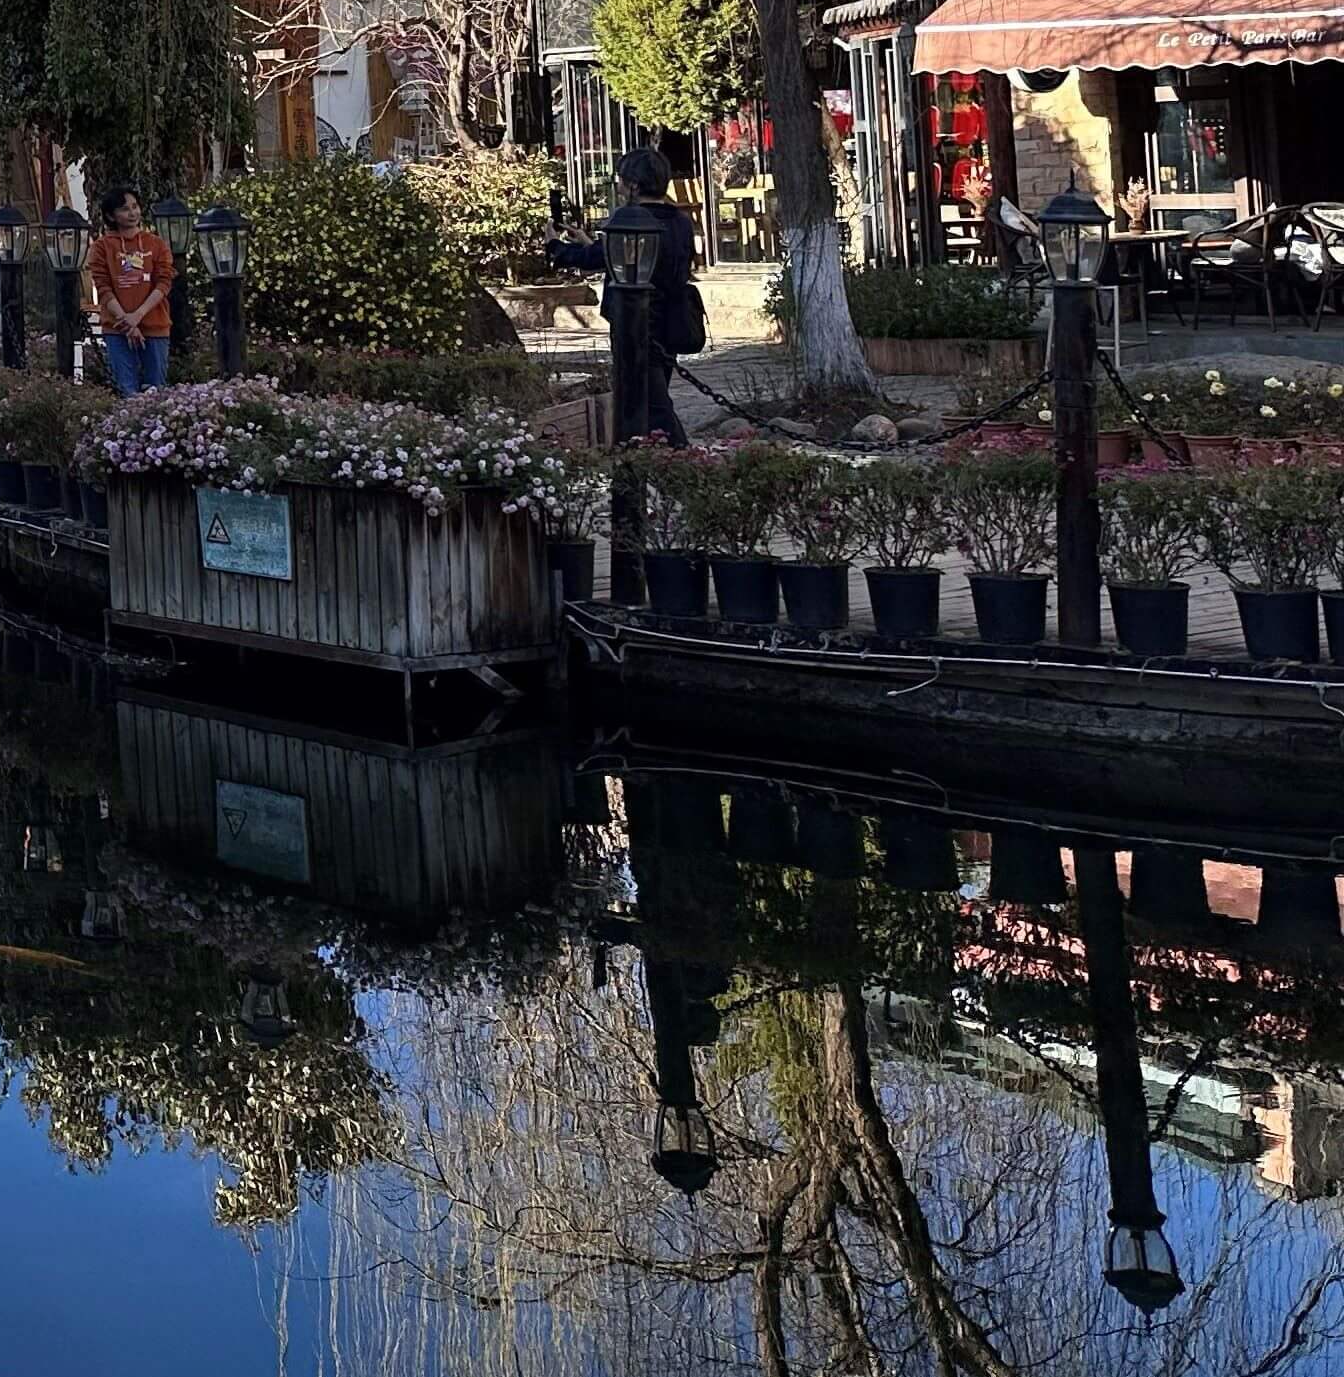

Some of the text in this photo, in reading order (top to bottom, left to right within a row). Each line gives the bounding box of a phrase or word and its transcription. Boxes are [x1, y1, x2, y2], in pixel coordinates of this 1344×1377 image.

[1157, 28, 1327, 48] Le Petit Paris Bar
